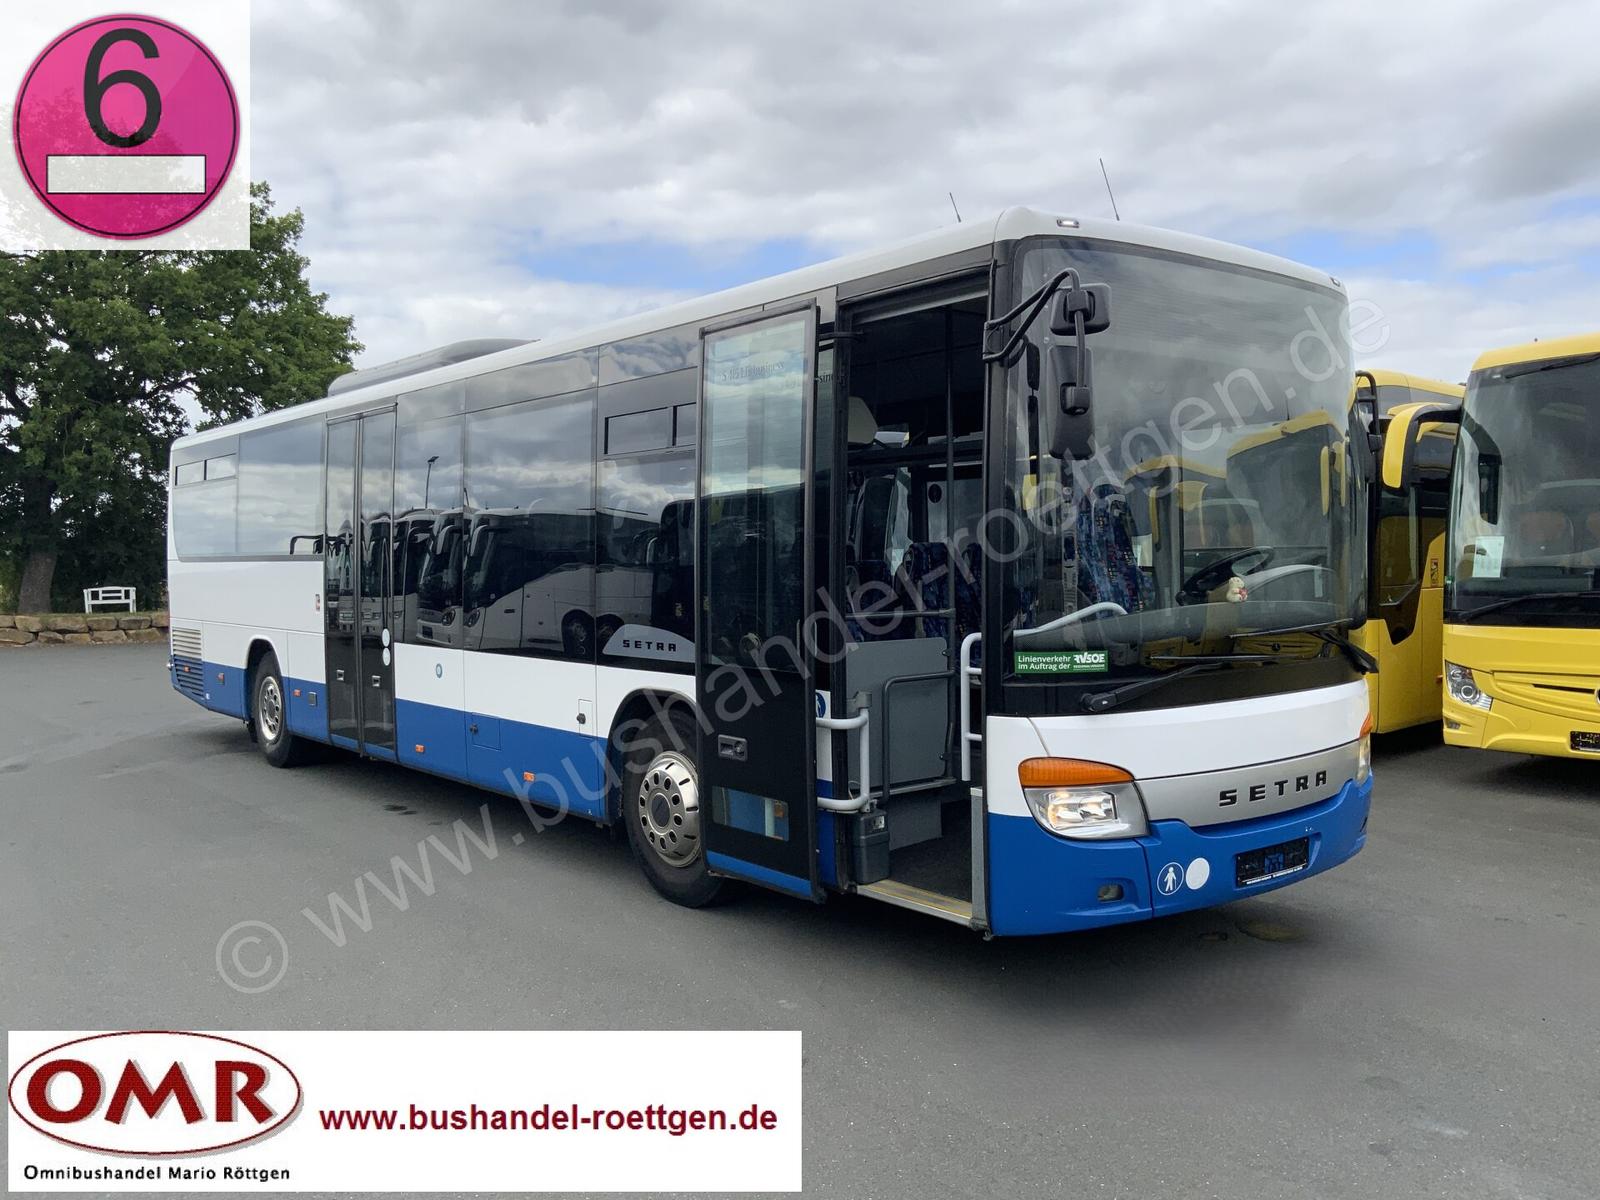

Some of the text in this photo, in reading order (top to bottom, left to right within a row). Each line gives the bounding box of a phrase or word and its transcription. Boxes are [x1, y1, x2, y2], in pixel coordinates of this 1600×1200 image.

[622, 639, 677, 652] SETRA
[1018, 655, 1071, 663] Linienverkehr
[1029, 662, 1057, 671] Auftrag
[1219, 770, 1327, 807] SETRA
